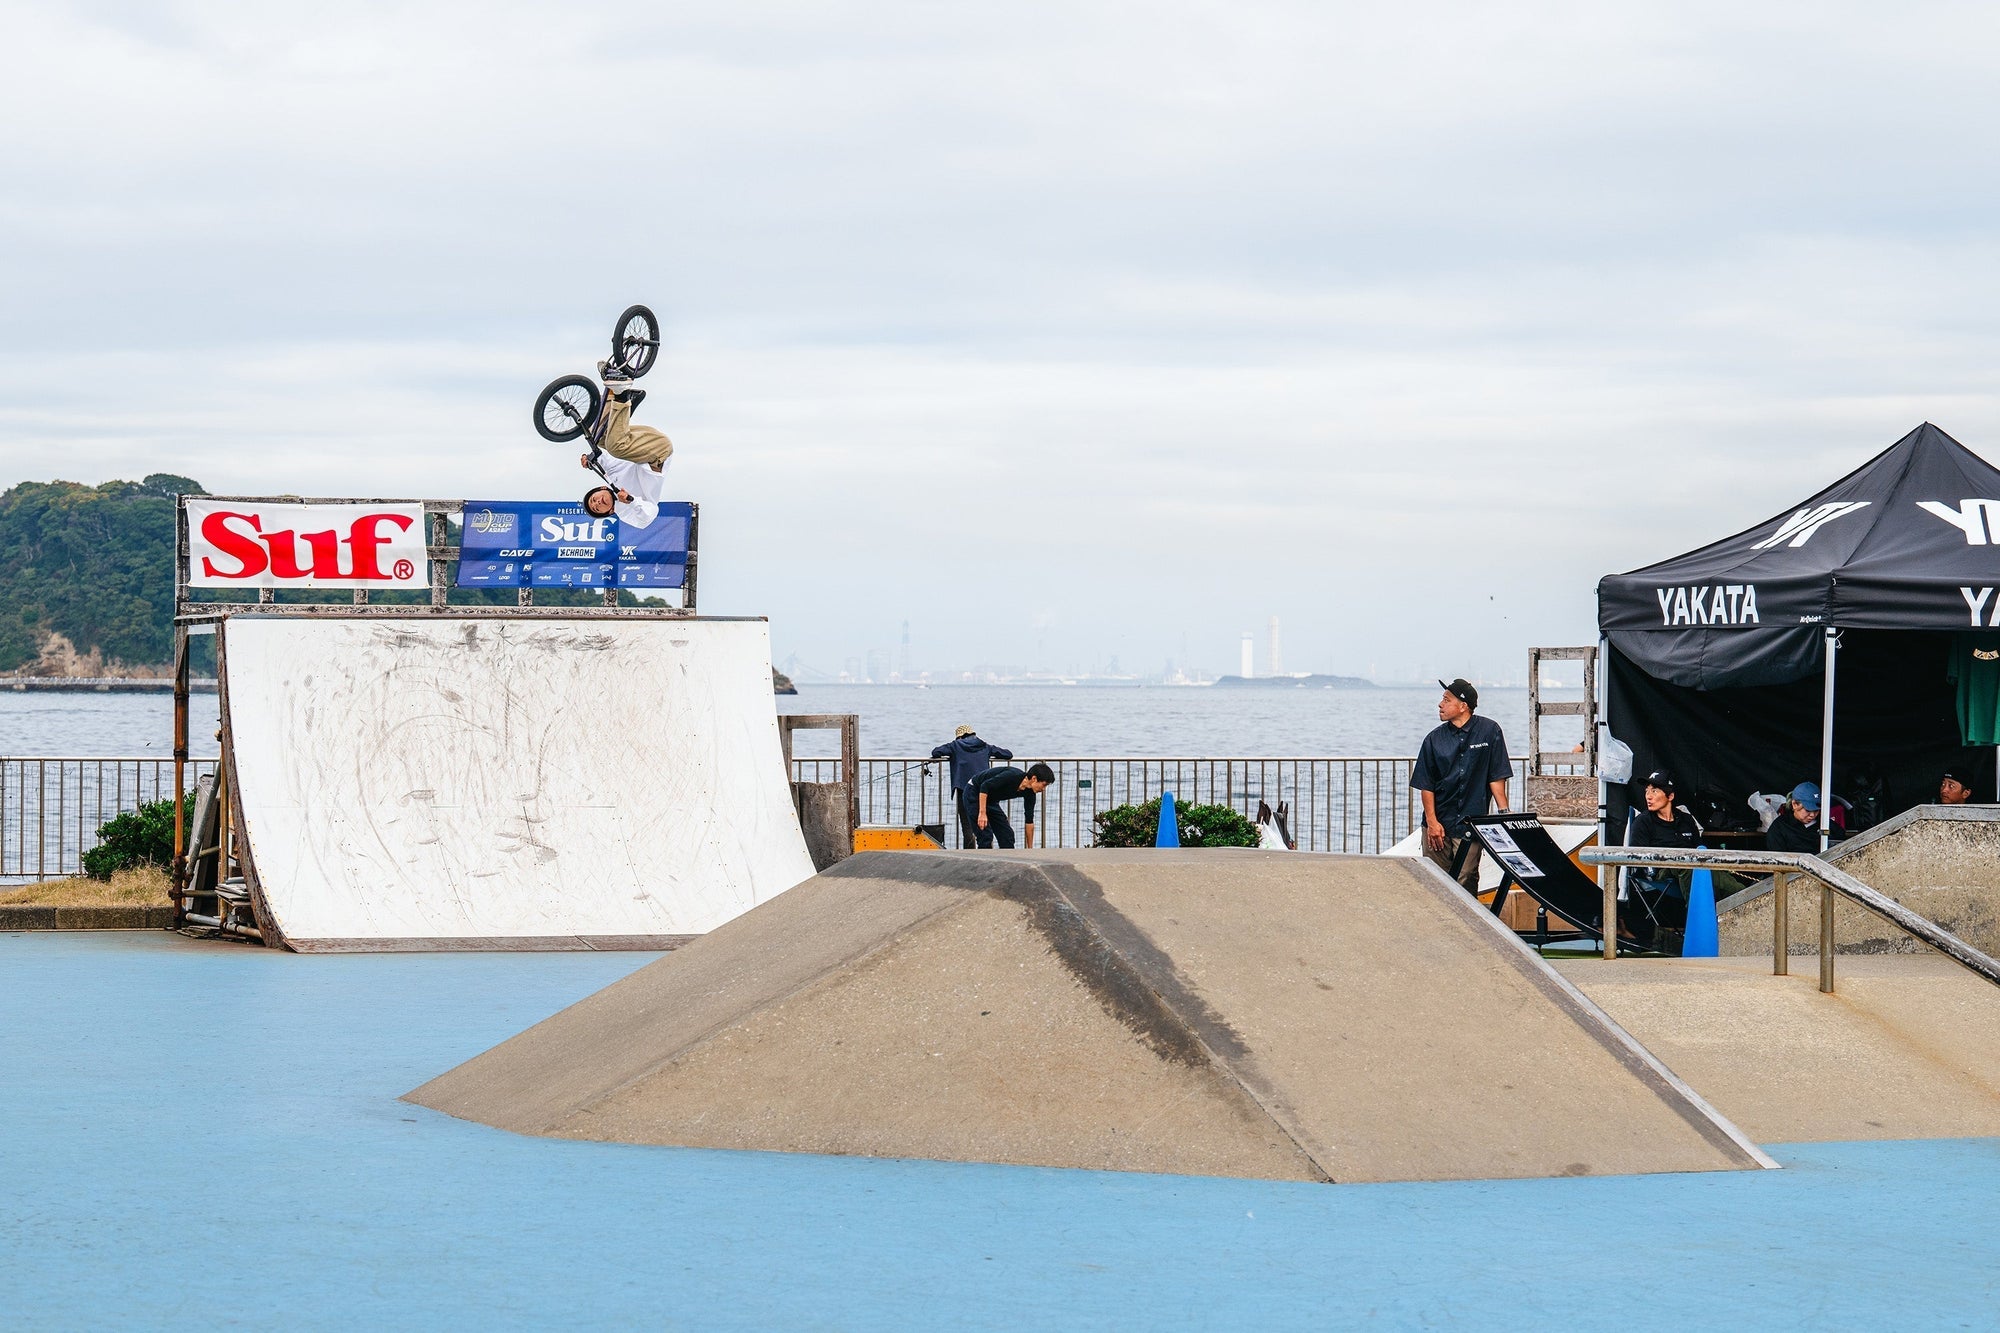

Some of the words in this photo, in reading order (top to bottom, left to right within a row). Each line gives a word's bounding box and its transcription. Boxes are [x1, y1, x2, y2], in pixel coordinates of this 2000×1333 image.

[499, 549, 535, 557] CAVE
[1656, 585, 1760, 626] YAKATA
[1512, 819, 1543, 830] YAKATA
